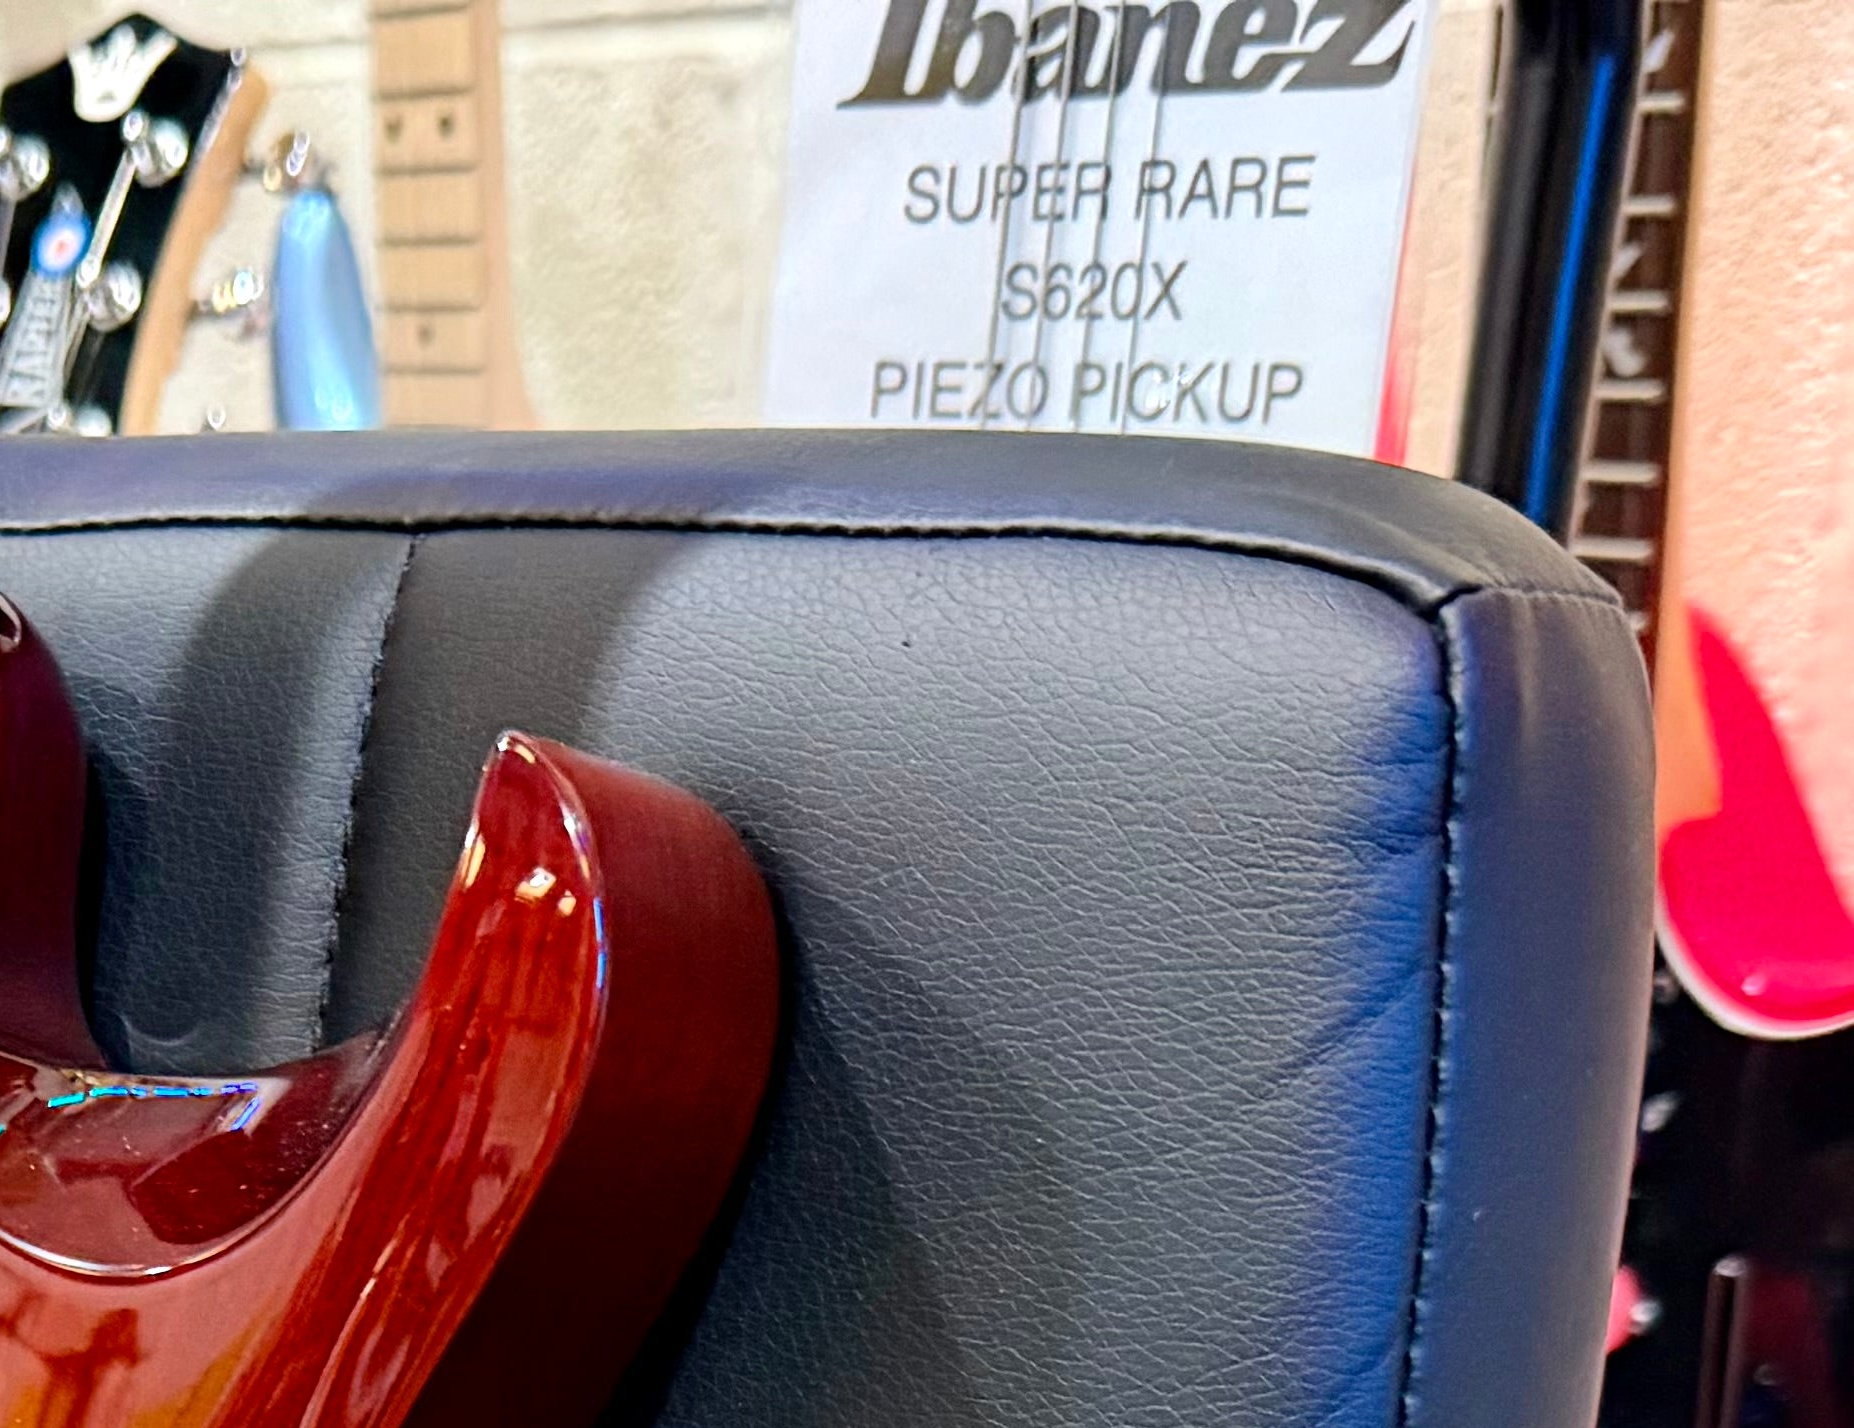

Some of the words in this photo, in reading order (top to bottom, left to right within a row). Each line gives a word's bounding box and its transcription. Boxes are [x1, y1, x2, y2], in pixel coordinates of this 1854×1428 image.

[836, 0, 1415, 110] Ibanez
[902, 160, 1112, 224] SUPER
[1135, 154, 1317, 221] RARE
[1001, 260, 1188, 322] S620X
[870, 360, 1048, 421] PIEZO
[1068, 360, 1304, 426] PICKUP
